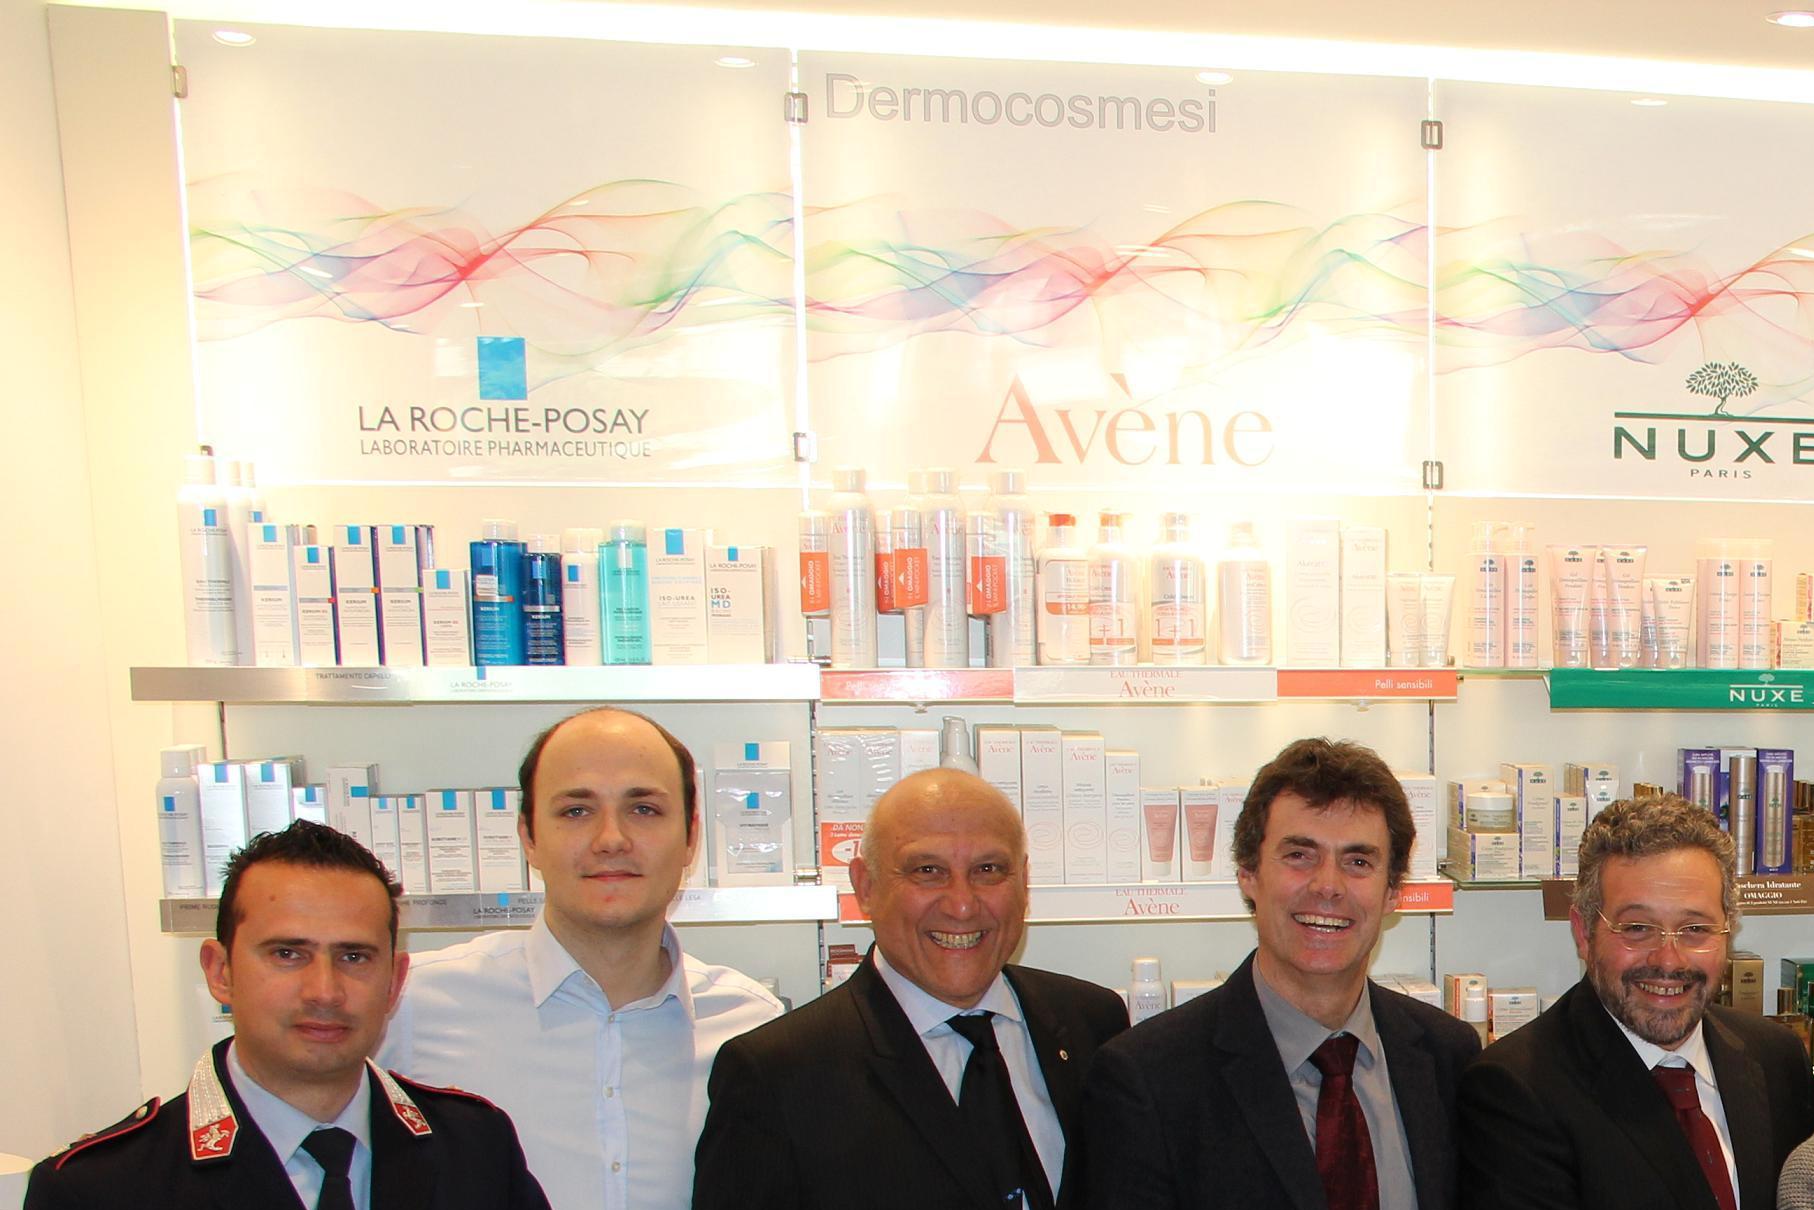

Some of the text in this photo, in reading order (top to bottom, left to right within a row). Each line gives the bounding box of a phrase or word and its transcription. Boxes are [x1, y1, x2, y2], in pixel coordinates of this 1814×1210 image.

[825, 72, 1218, 133] Dermocosmesi
[358, 405, 650, 434] LA ROCHE-POSAY
[974, 371, 1275, 468] Avène
[360, 438, 652, 460] LABORATOIRE PHARMACEUTIQUE
[1690, 467, 1754, 480] PARIS
[711, 600, 731, 609] MD
[1110, 671, 1183, 679] EAU THERMALE
[1119, 680, 1176, 699] Avène
[1375, 679, 1433, 689] Pelli sensibili
[1730, 688, 1804, 702] NUXE
[1070, 752, 1097, 762] Avène
[1115, 887, 1188, 897] EAU THERMALE
[1124, 898, 1180, 916] Avène
